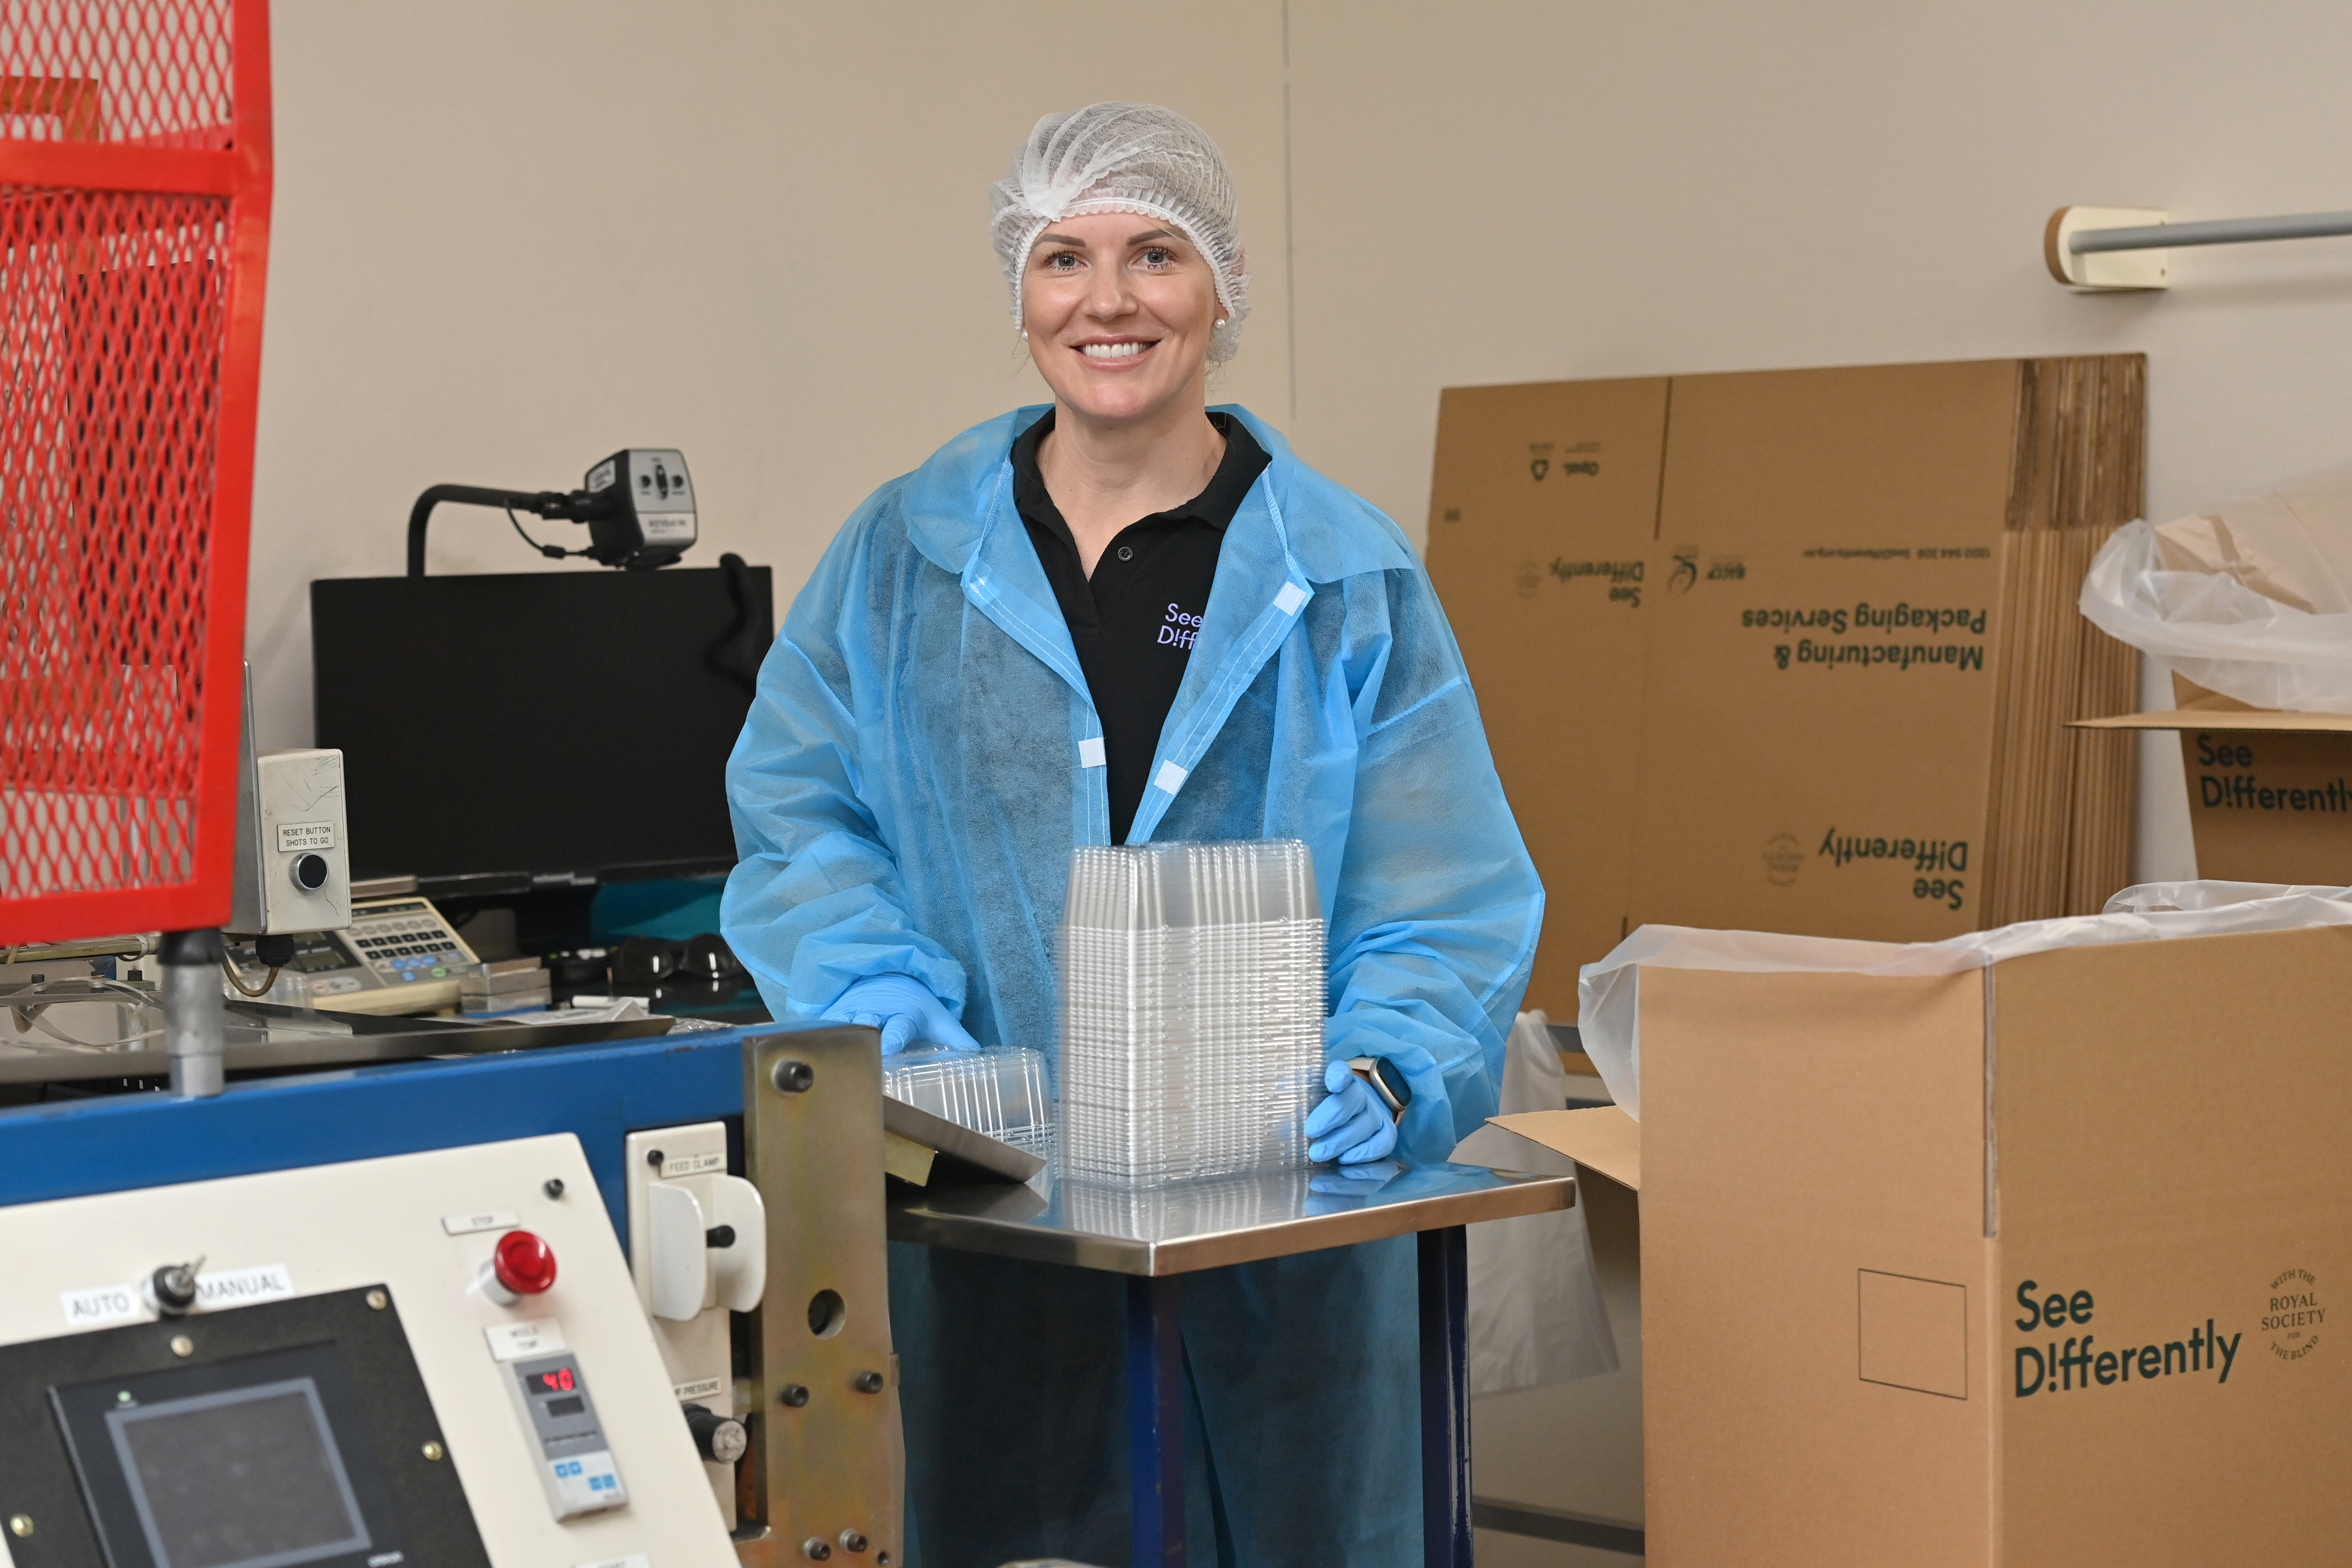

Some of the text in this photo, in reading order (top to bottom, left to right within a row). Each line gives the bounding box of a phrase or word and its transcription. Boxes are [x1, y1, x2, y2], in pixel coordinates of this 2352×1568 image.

[1165, 603, 1203, 628] See
[1742, 602, 1987, 634] Packaging Services
[1775, 639, 1984, 671] Manufacturing &
[2197, 733, 2253, 767] See
[283, 826, 331, 836] RESET BUTTON
[286, 838, 307, 847] SHOTS
[1819, 827, 1968, 873] D!fferently
[1913, 879, 1965, 911] See
[2271, 1269, 2316, 1289] WITH THE
[72, 1272, 286, 1318] AUTO MANUAL
[2015, 1279, 2094, 1333] See
[2270, 1292, 2318, 1312] ROYAL
[2262, 1308, 2326, 1331] SOCIETY
[2270, 1335, 2319, 1360] THE BLIND
[2287, 1331, 2301, 1340] FOR
[2014, 1318, 2242, 1398] D!fferently
[542, 1368, 574, 1391] 40
[684, 1381, 718, 1395] PRESSURE
